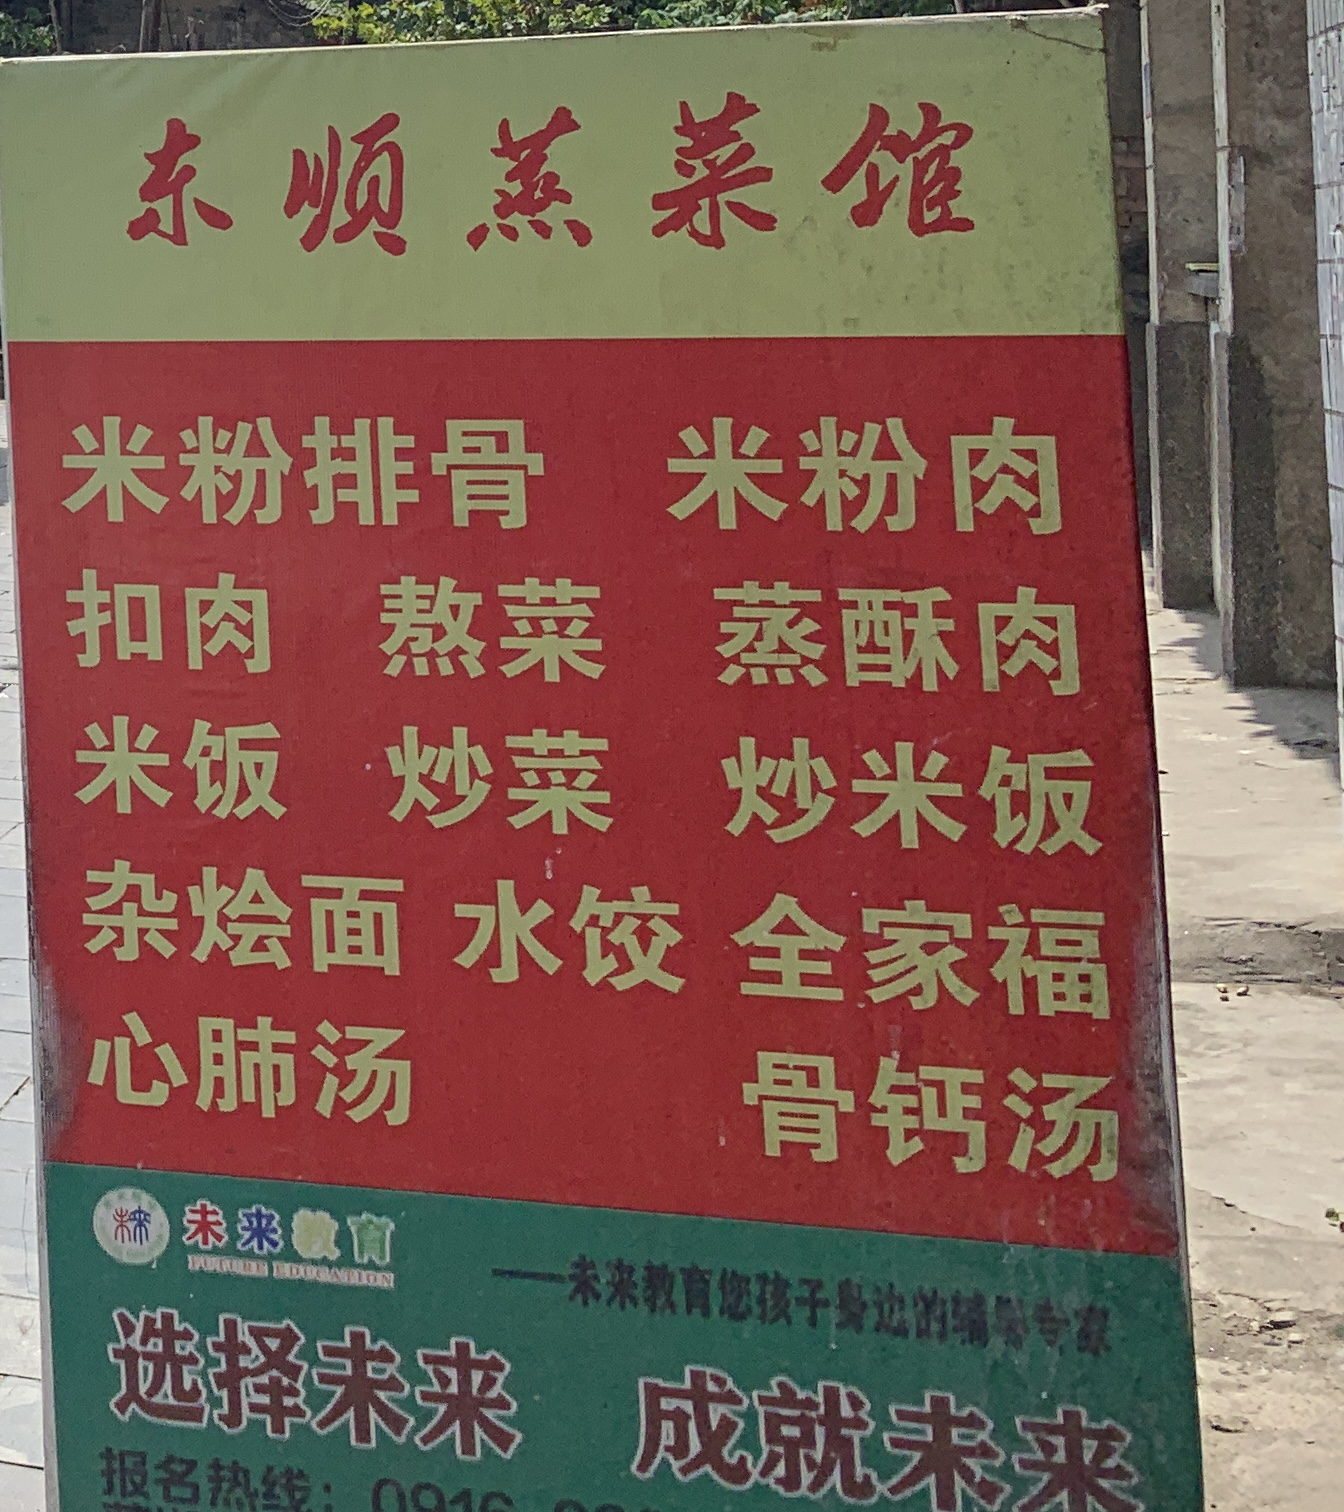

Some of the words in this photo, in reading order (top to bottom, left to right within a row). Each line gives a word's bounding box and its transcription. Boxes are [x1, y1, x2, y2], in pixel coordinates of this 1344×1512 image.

[127, 92, 975, 256] 东顺蒸菜馆
[63, 415, 545, 529] 米粉排骨
[667, 416, 1062, 535] 米粉肉
[67, 568, 271, 673] 扣肉
[379, 575, 606, 683] 熬菜
[714, 581, 1080, 696] 蒸酥肉
[75, 715, 287, 820] 米饭
[386, 726, 613, 835] 炒菜
[721, 737, 1102, 855] 炒米饭
[83, 860, 404, 976] 杂烩面
[454, 880, 685, 993] 水饺
[731, 893, 1111, 1019] 全家福
[88, 1012, 411, 1126] 心肺汤
[742, 1051, 1118, 1182] 骨钙汤
[188, 1254, 269, 1277] FUTURE
[272, 1261, 394, 1288] EDUCATION
[107, 1307, 523, 1461] 选择未来
[635, 1365, 1146, 1512] 成就未来
